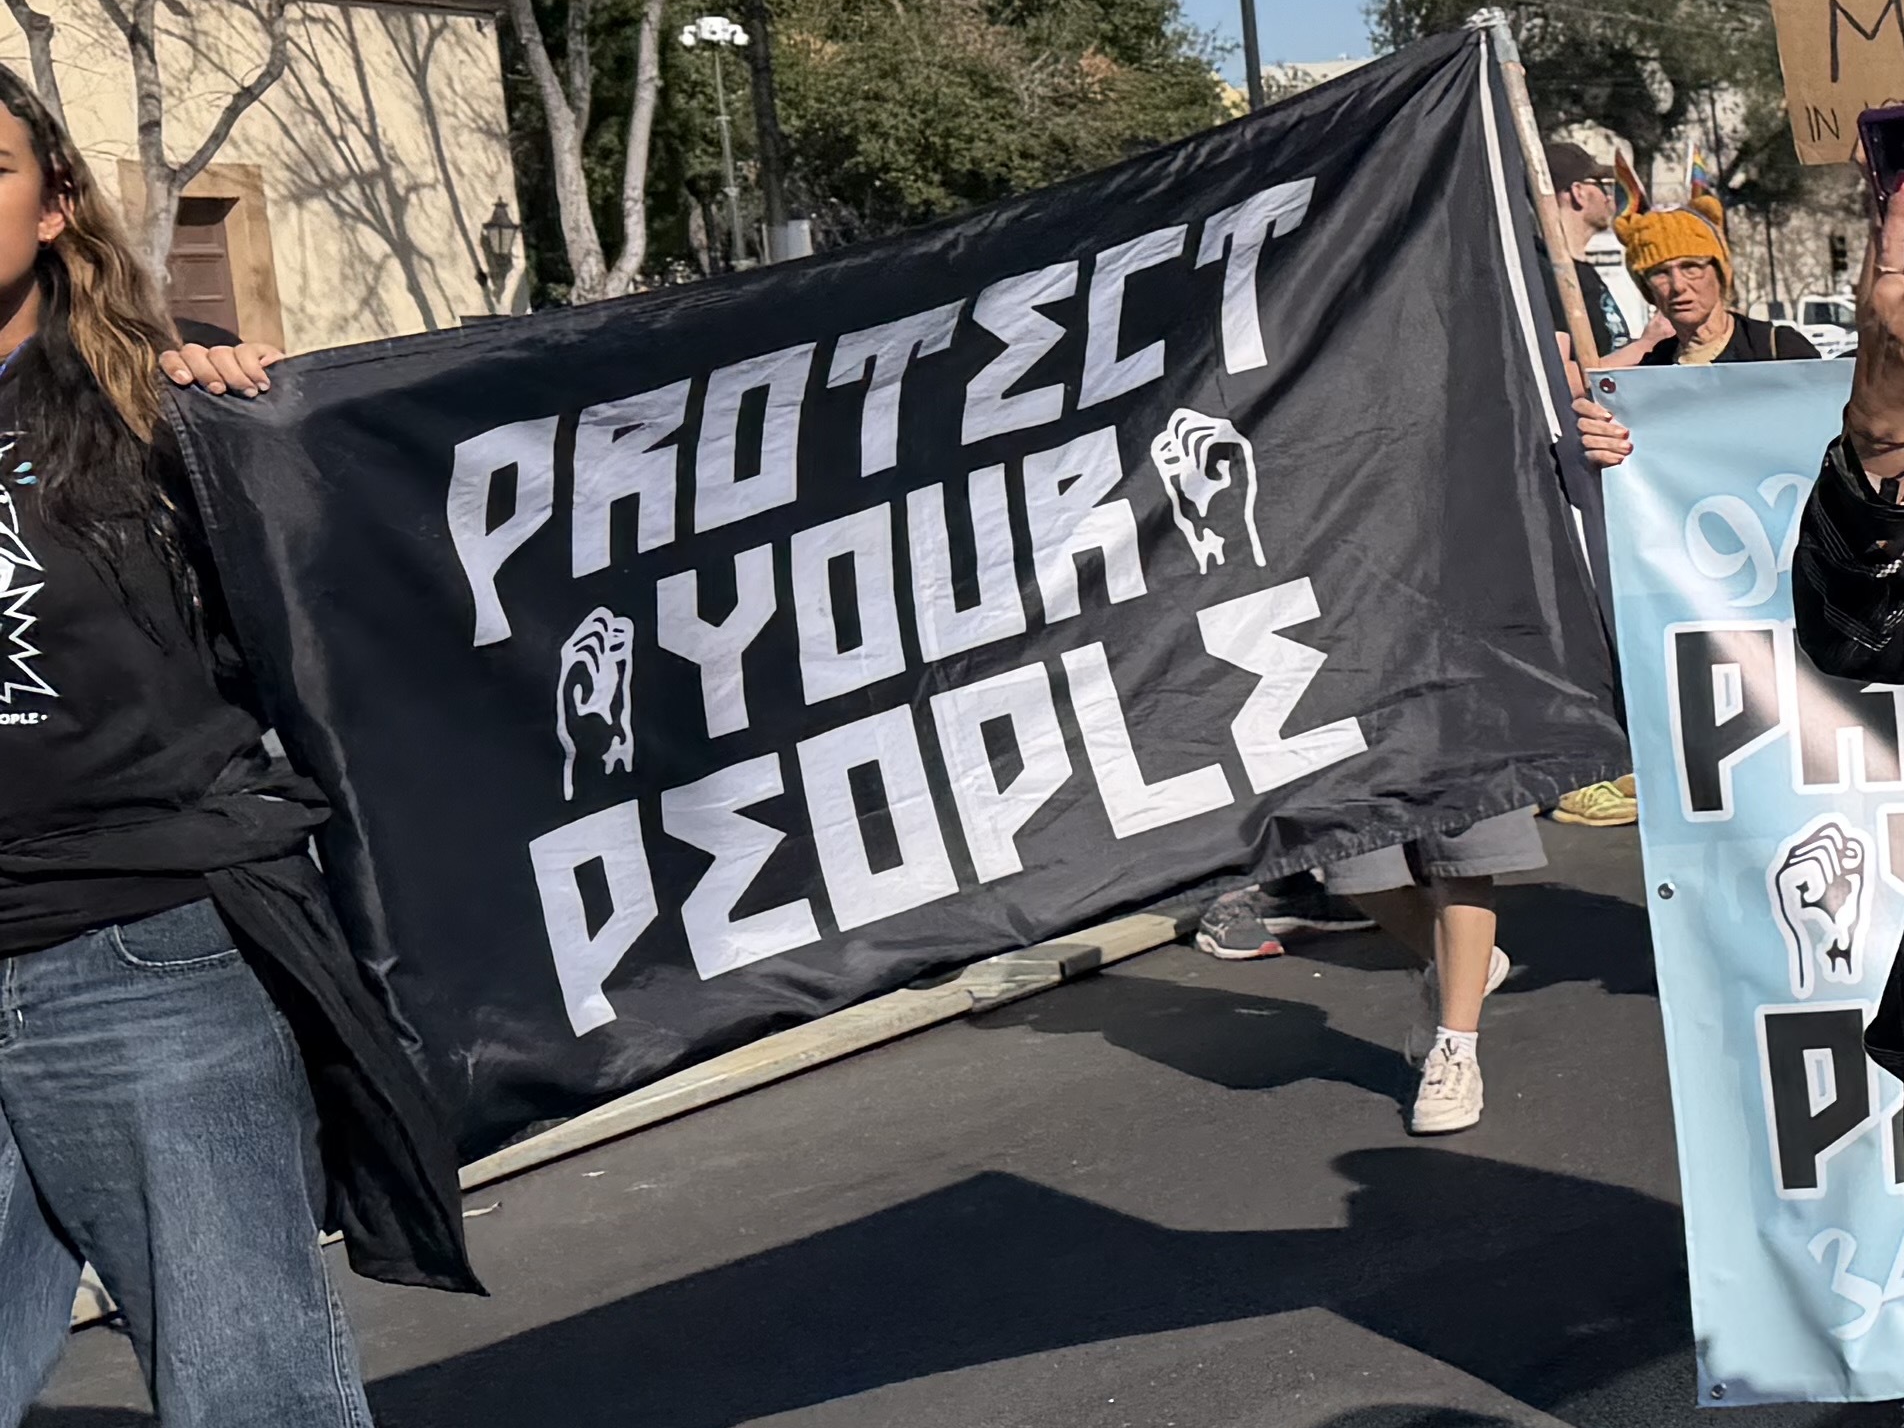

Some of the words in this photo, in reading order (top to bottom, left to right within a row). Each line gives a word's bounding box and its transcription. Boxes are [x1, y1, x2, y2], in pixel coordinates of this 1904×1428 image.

[1804, 105, 1840, 142] IN
[447, 177, 1316, 647] PROTECT
[658, 425, 1149, 740] YOUR
[529, 577, 1369, 1036] PEOPLE
